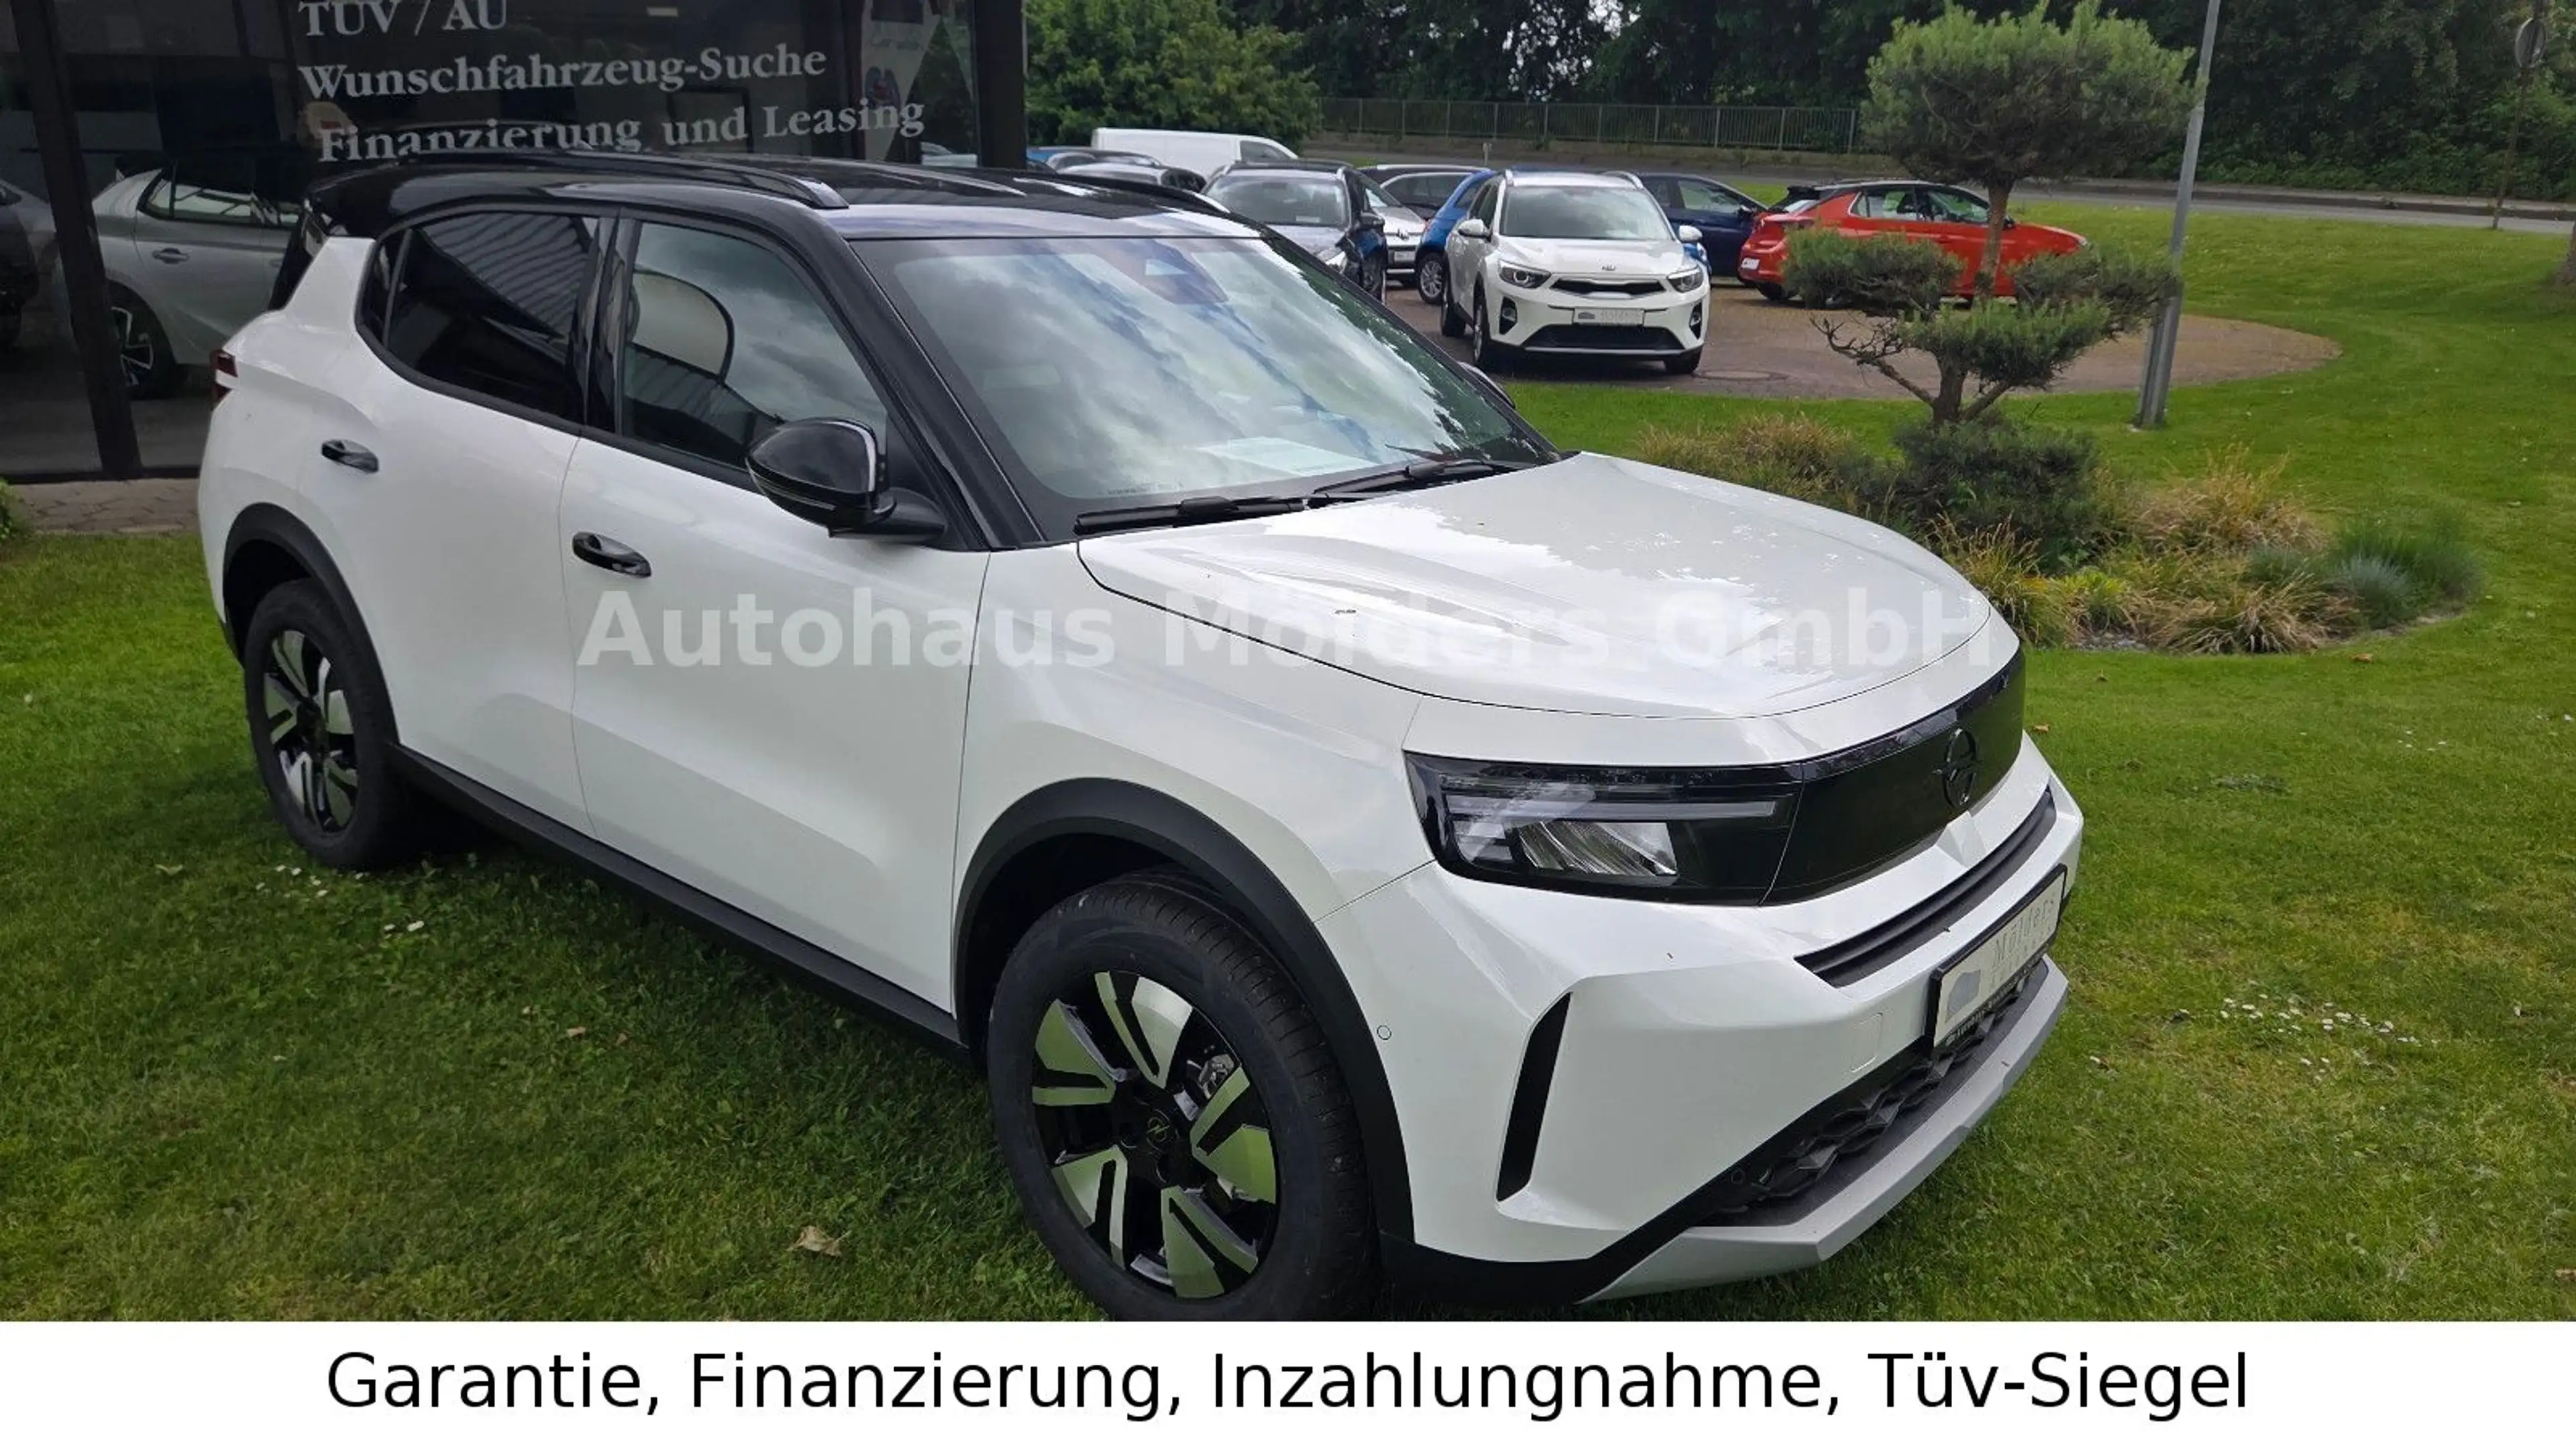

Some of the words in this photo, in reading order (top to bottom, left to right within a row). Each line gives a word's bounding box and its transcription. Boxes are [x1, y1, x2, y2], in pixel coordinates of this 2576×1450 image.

[414, 0, 431, 36] /
[441, 0, 506, 31] AU
[298, 43, 826, 99] Wunschfahrzeug-Suche
[317, 118, 642, 162] Finanzierung
[661, 107, 747, 146] und
[763, 97, 925, 138] Leasing
